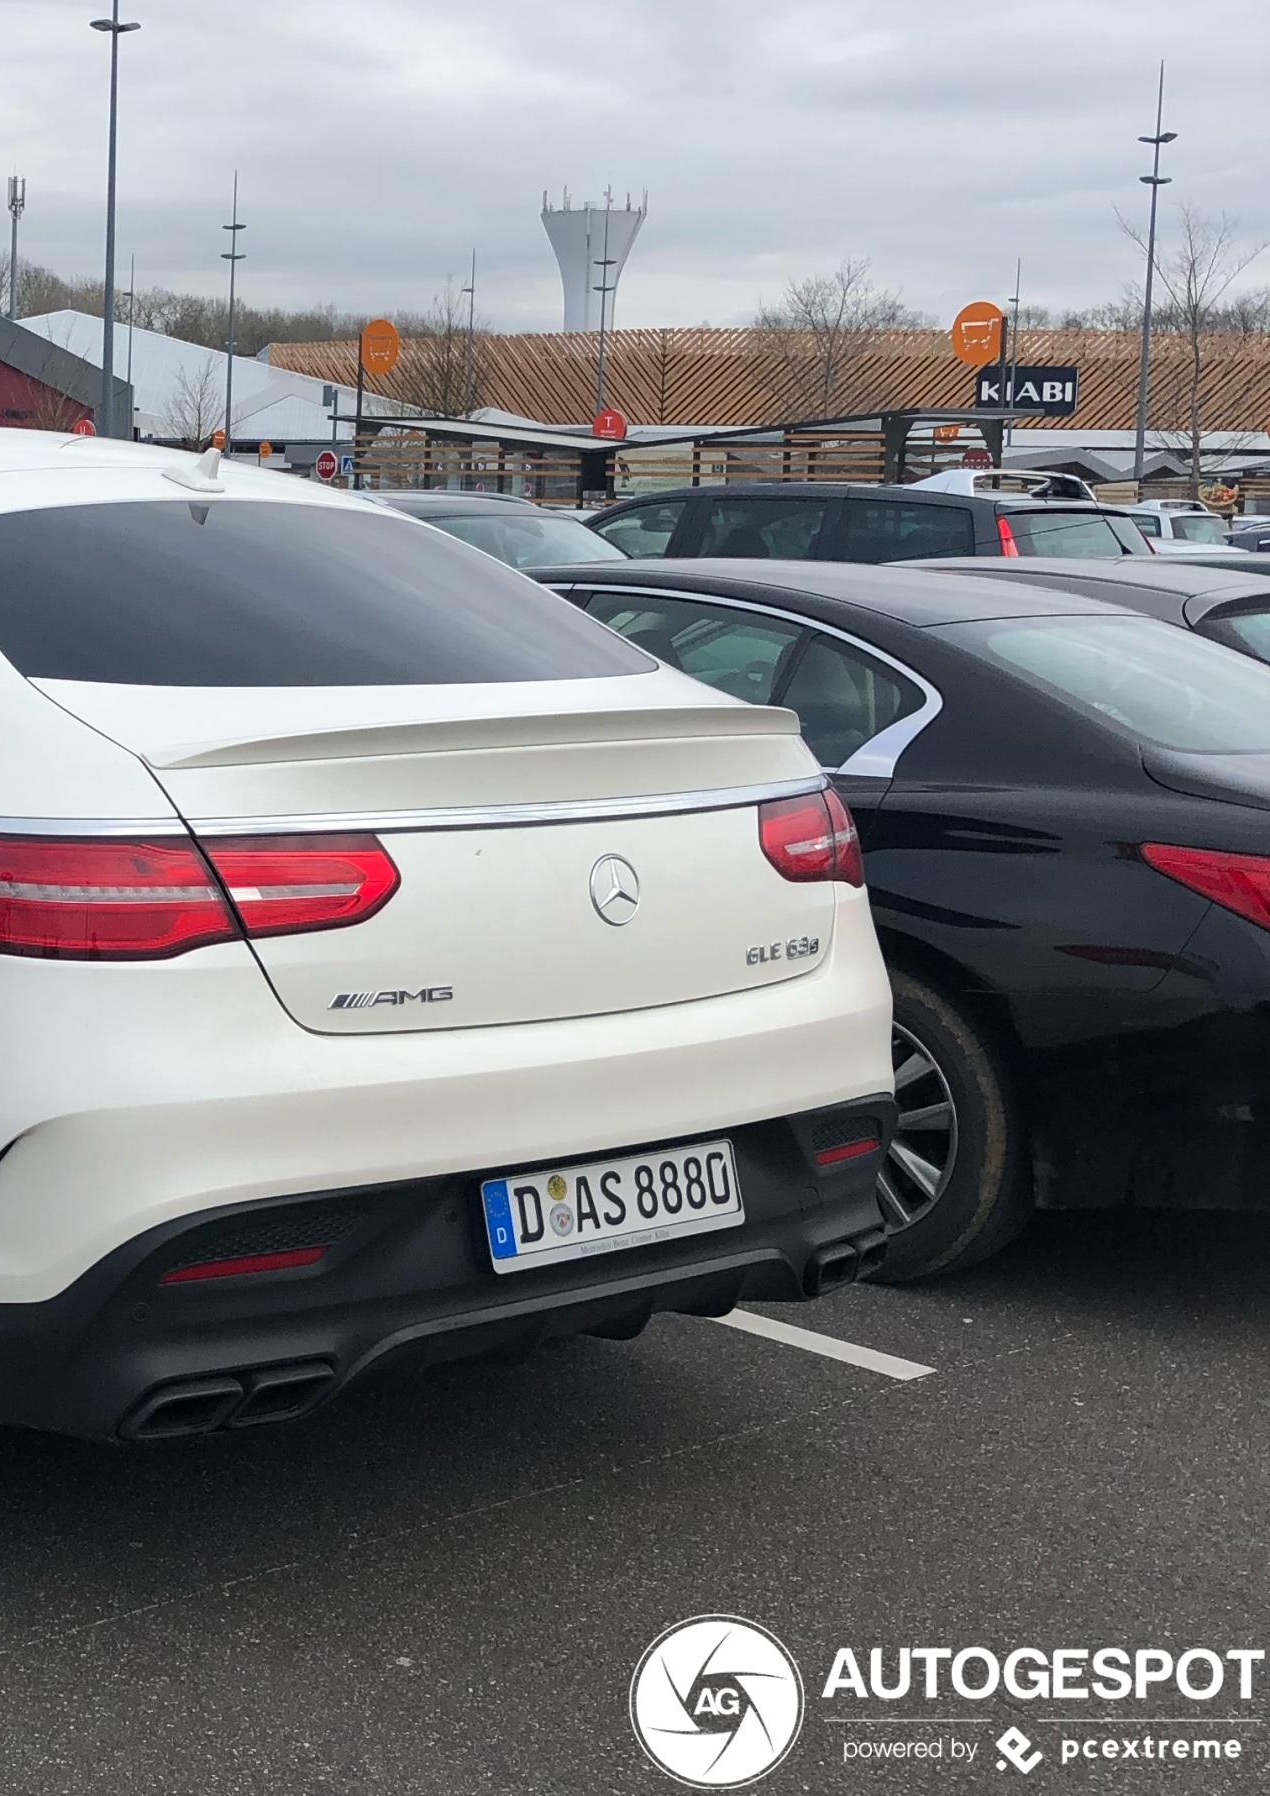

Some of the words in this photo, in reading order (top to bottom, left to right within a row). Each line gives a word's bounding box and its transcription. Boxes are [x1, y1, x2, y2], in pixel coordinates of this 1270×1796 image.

[981, 381, 1073, 402] KIABI
[318, 461, 335, 470] STOP
[746, 942, 782, 965] GLE
[576, 1171, 627, 1233] AS
[634, 1152, 731, 1219] 8880
[496, 1227, 507, 1244] D
